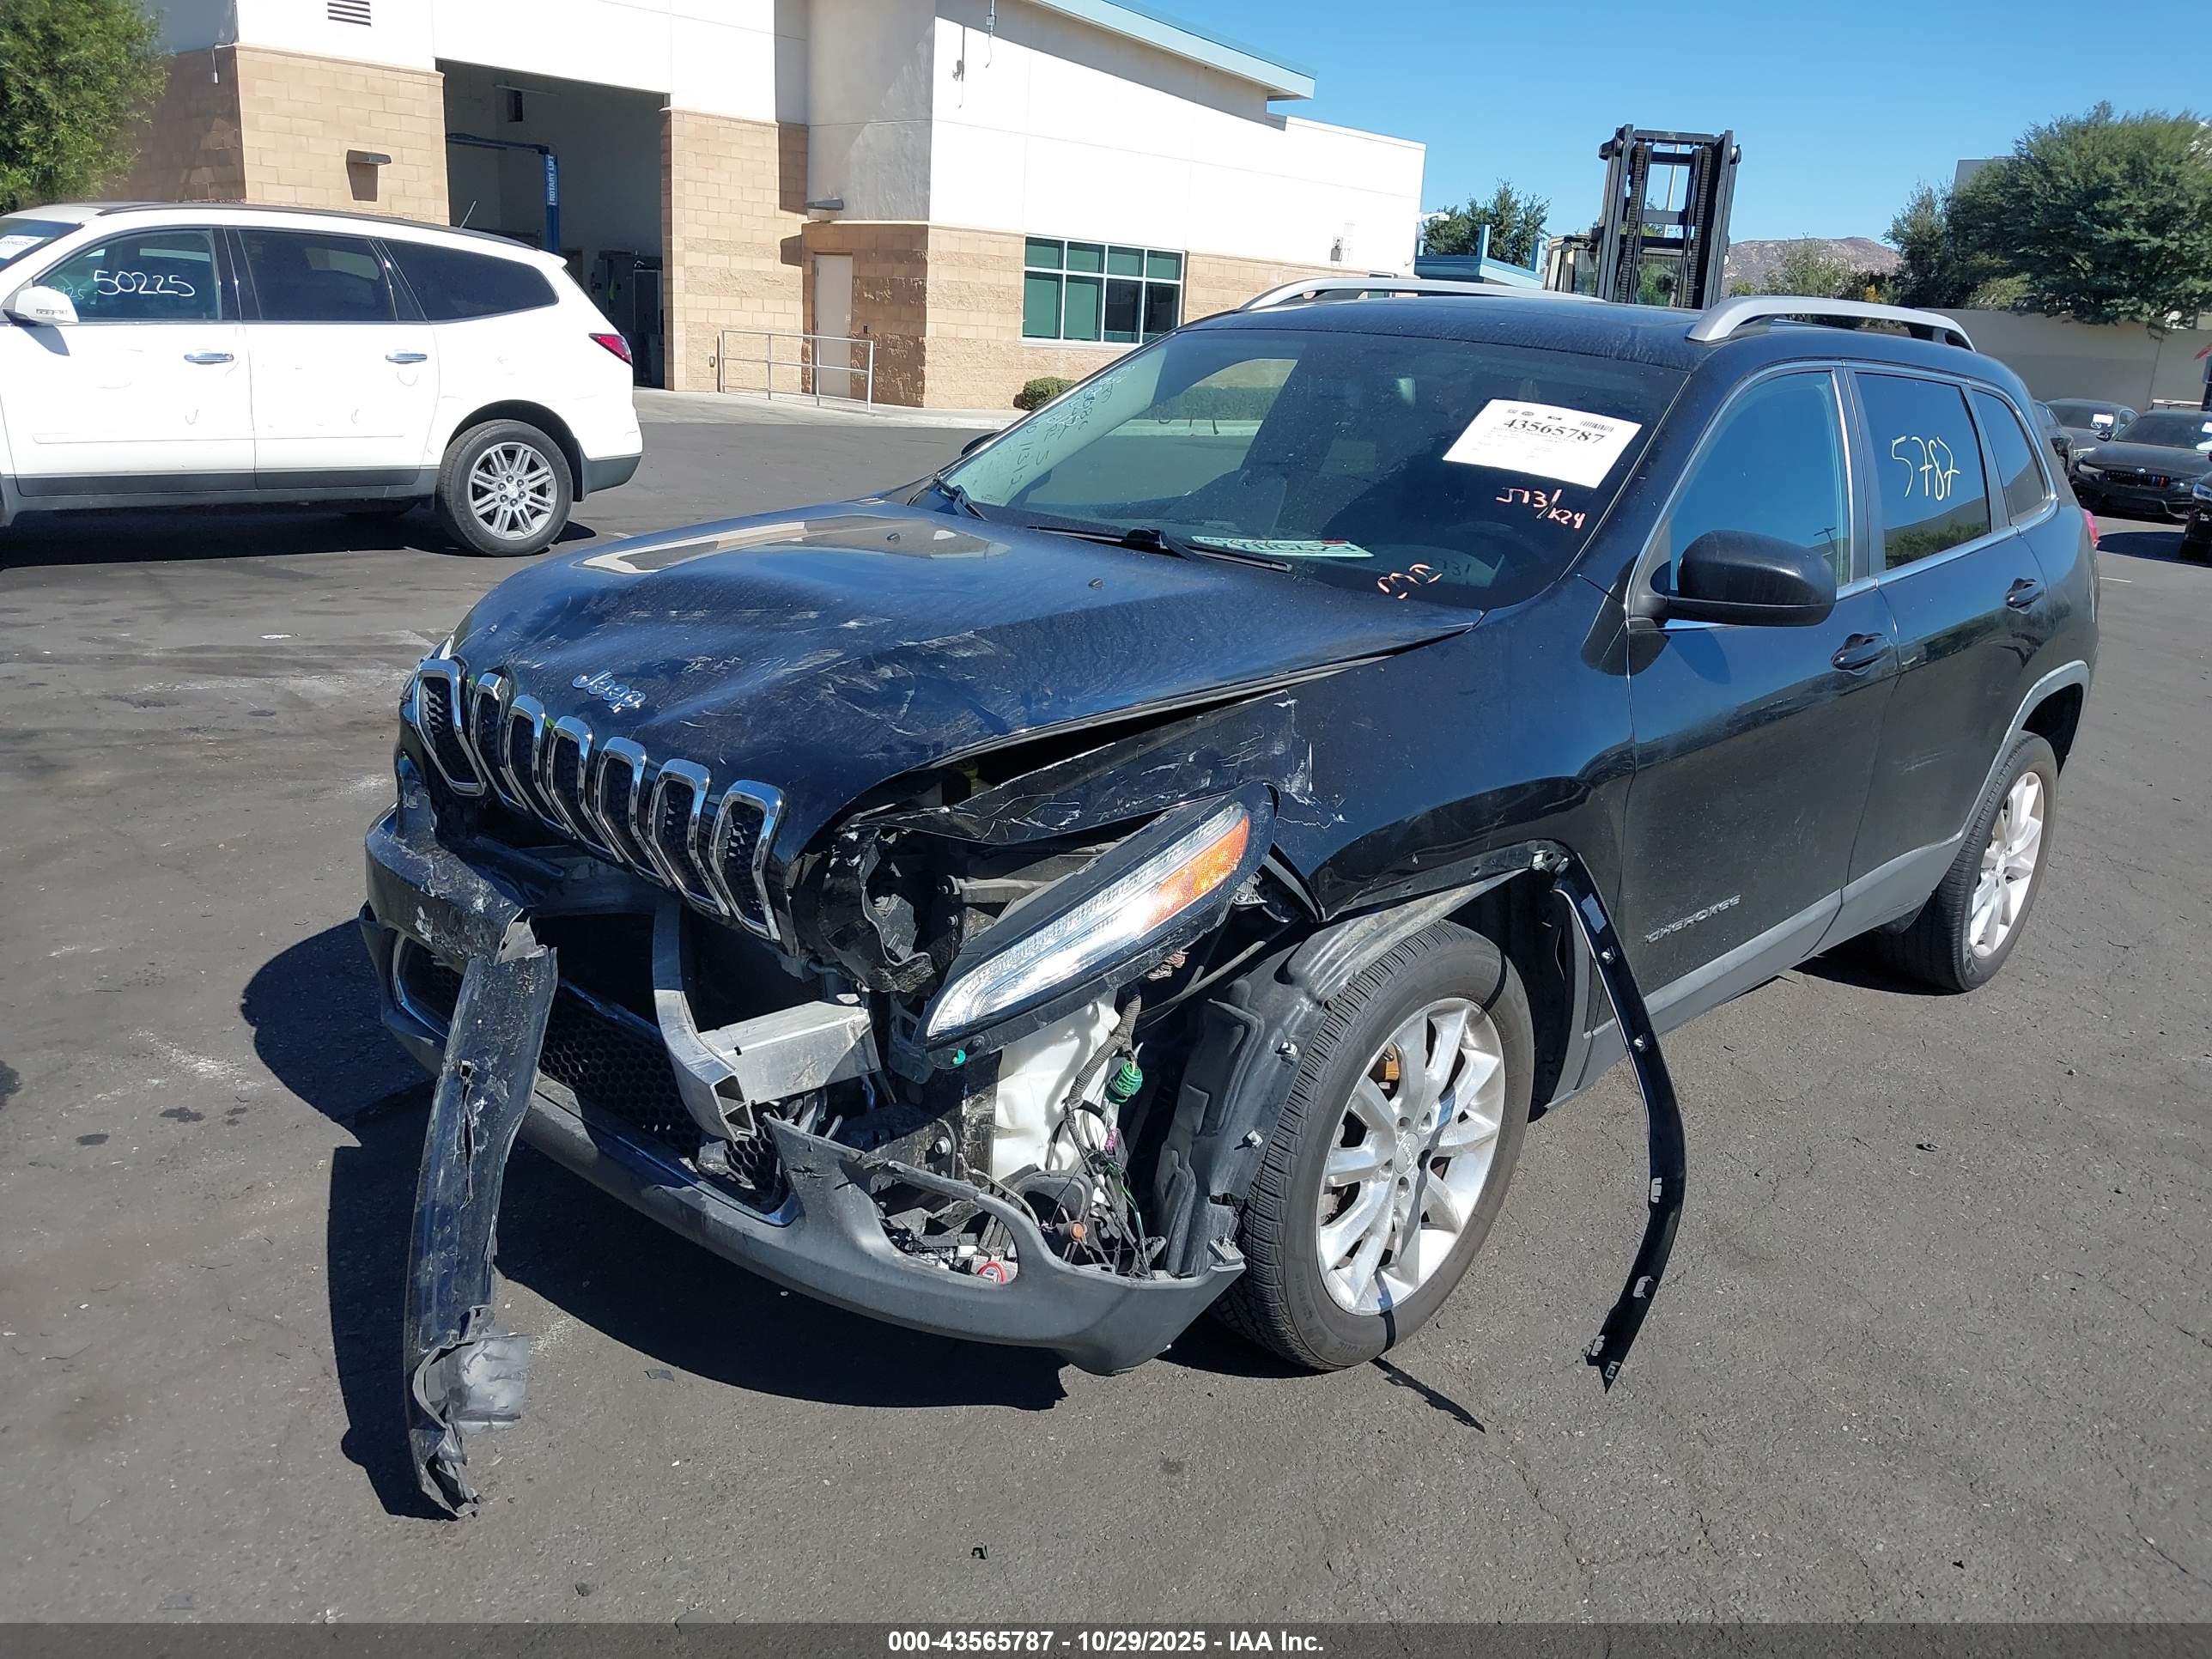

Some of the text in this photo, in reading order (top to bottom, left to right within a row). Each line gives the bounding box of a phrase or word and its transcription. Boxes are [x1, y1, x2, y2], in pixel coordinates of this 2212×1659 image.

[93, 270, 196, 297] 50225
[1503, 418, 1606, 444] 43565787
[1891, 435, 1960, 501] 5787
[572, 670, 647, 714] Jeep
[1647, 894, 1742, 944] CHEROKEE
